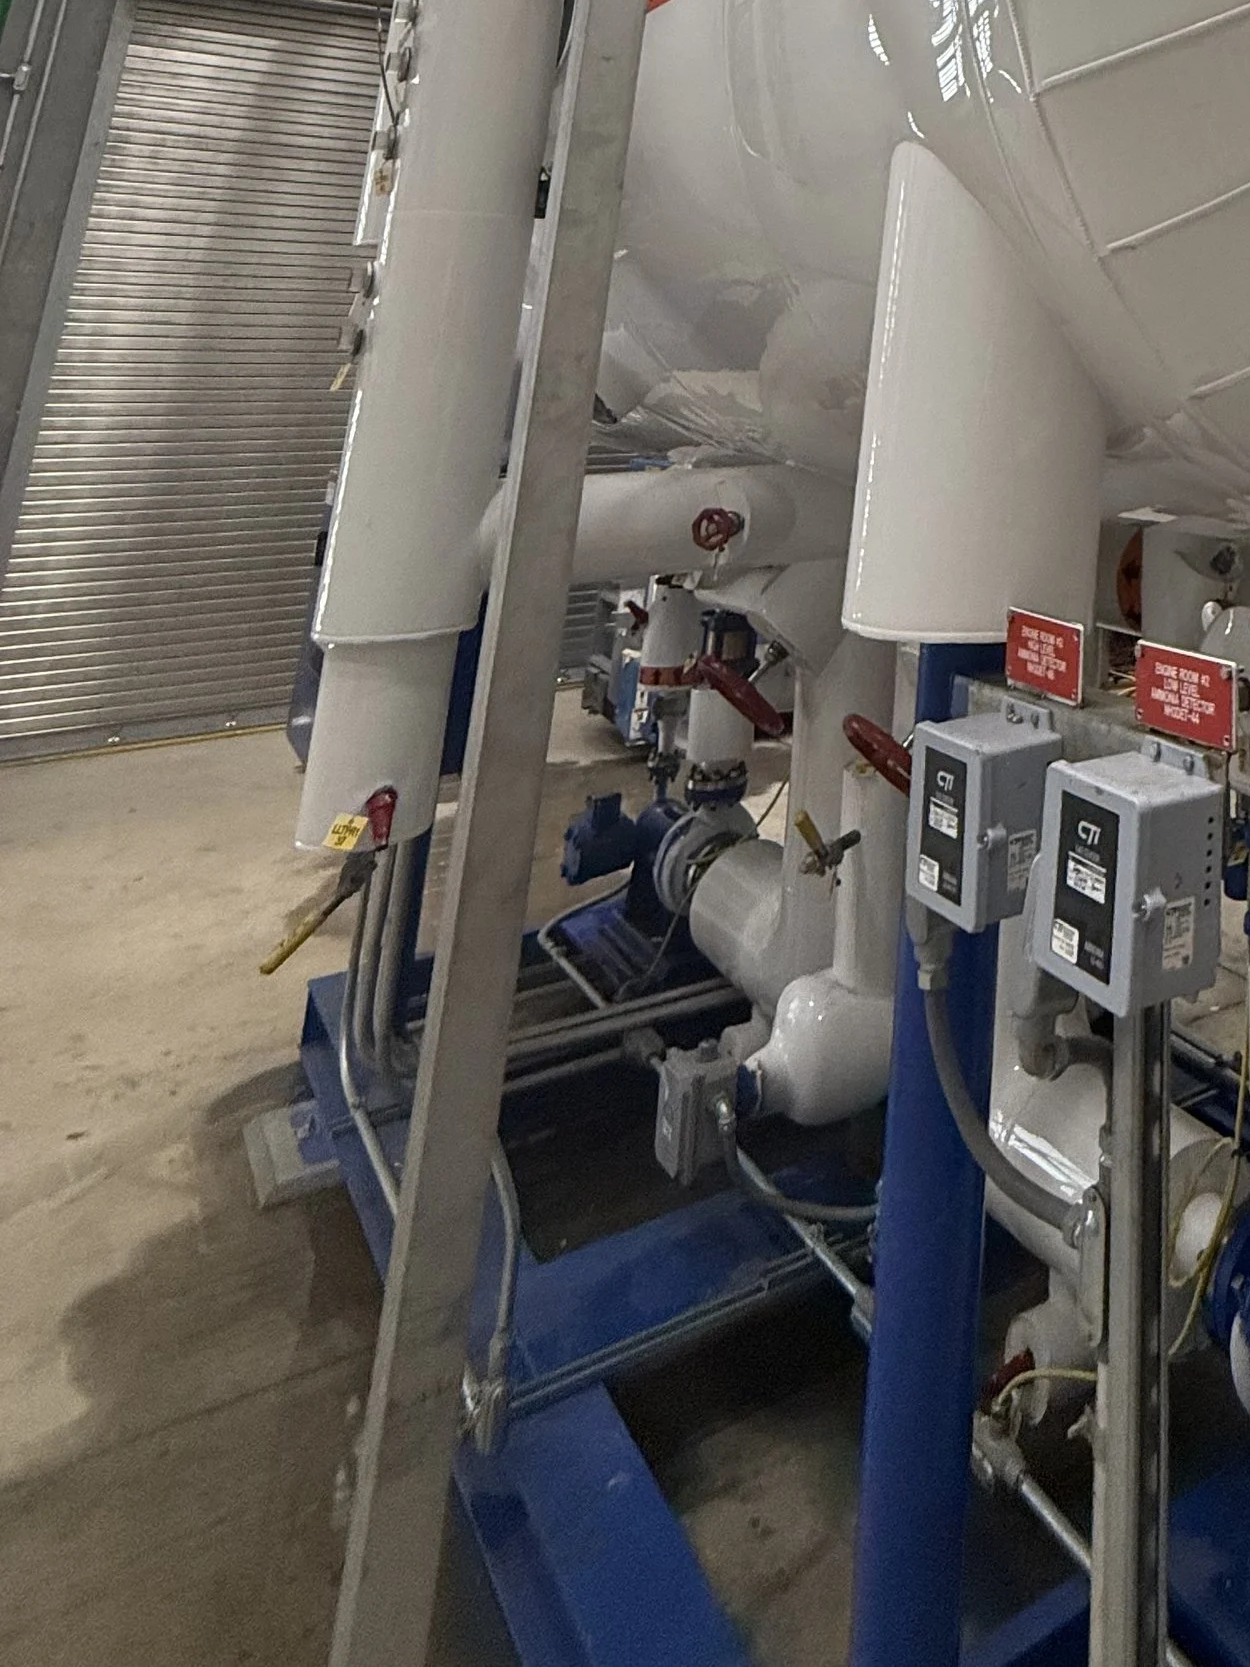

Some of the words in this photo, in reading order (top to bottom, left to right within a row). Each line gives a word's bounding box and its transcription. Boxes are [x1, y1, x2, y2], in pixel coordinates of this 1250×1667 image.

[1155, 661, 1178, 679] ENGINE
[1179, 668, 1199, 684] ROOM
[1163, 677, 1179, 692] LOW
[1179, 681, 1201, 698] LEVEL
[1180, 694, 1216, 716] DETECTOR
[1077, 820, 1102, 846] CTI
